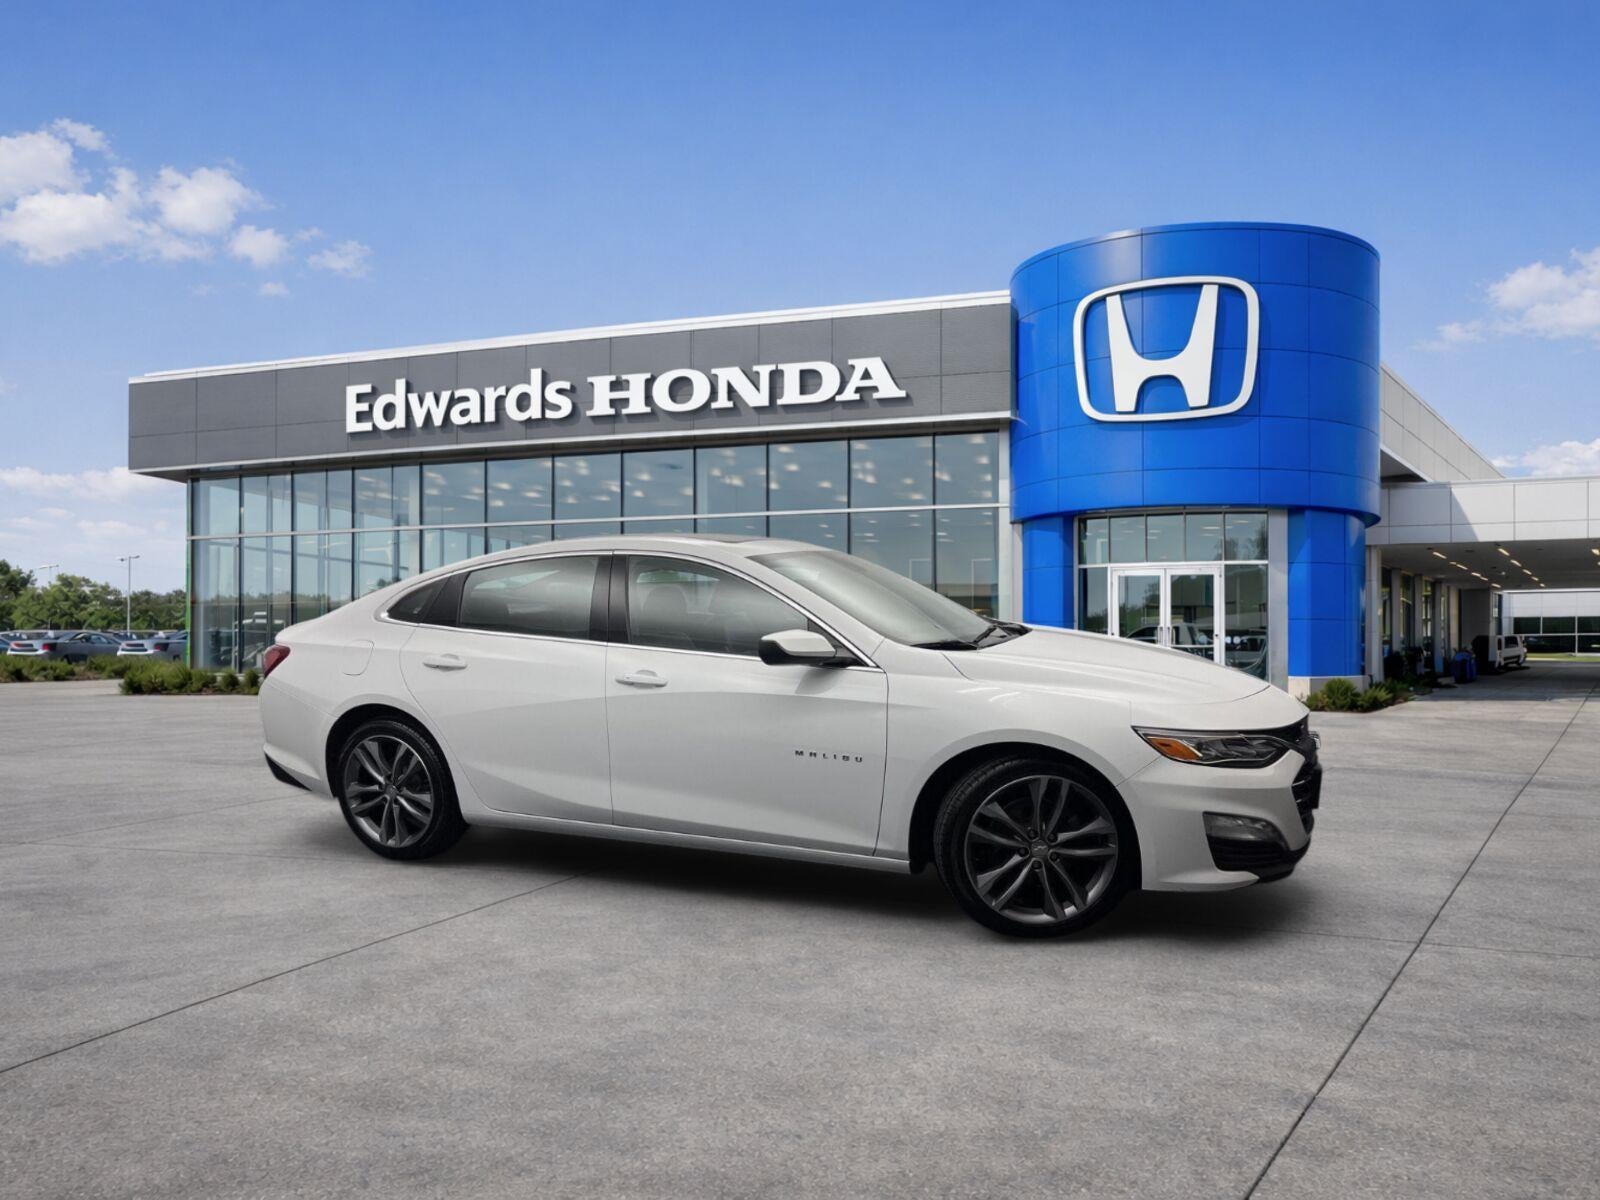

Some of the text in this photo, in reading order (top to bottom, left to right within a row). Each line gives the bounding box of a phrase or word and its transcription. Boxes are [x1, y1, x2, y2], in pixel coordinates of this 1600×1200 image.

[345, 357, 906, 434] Edwards HONDA
[794, 749, 863, 763] MALIBU
